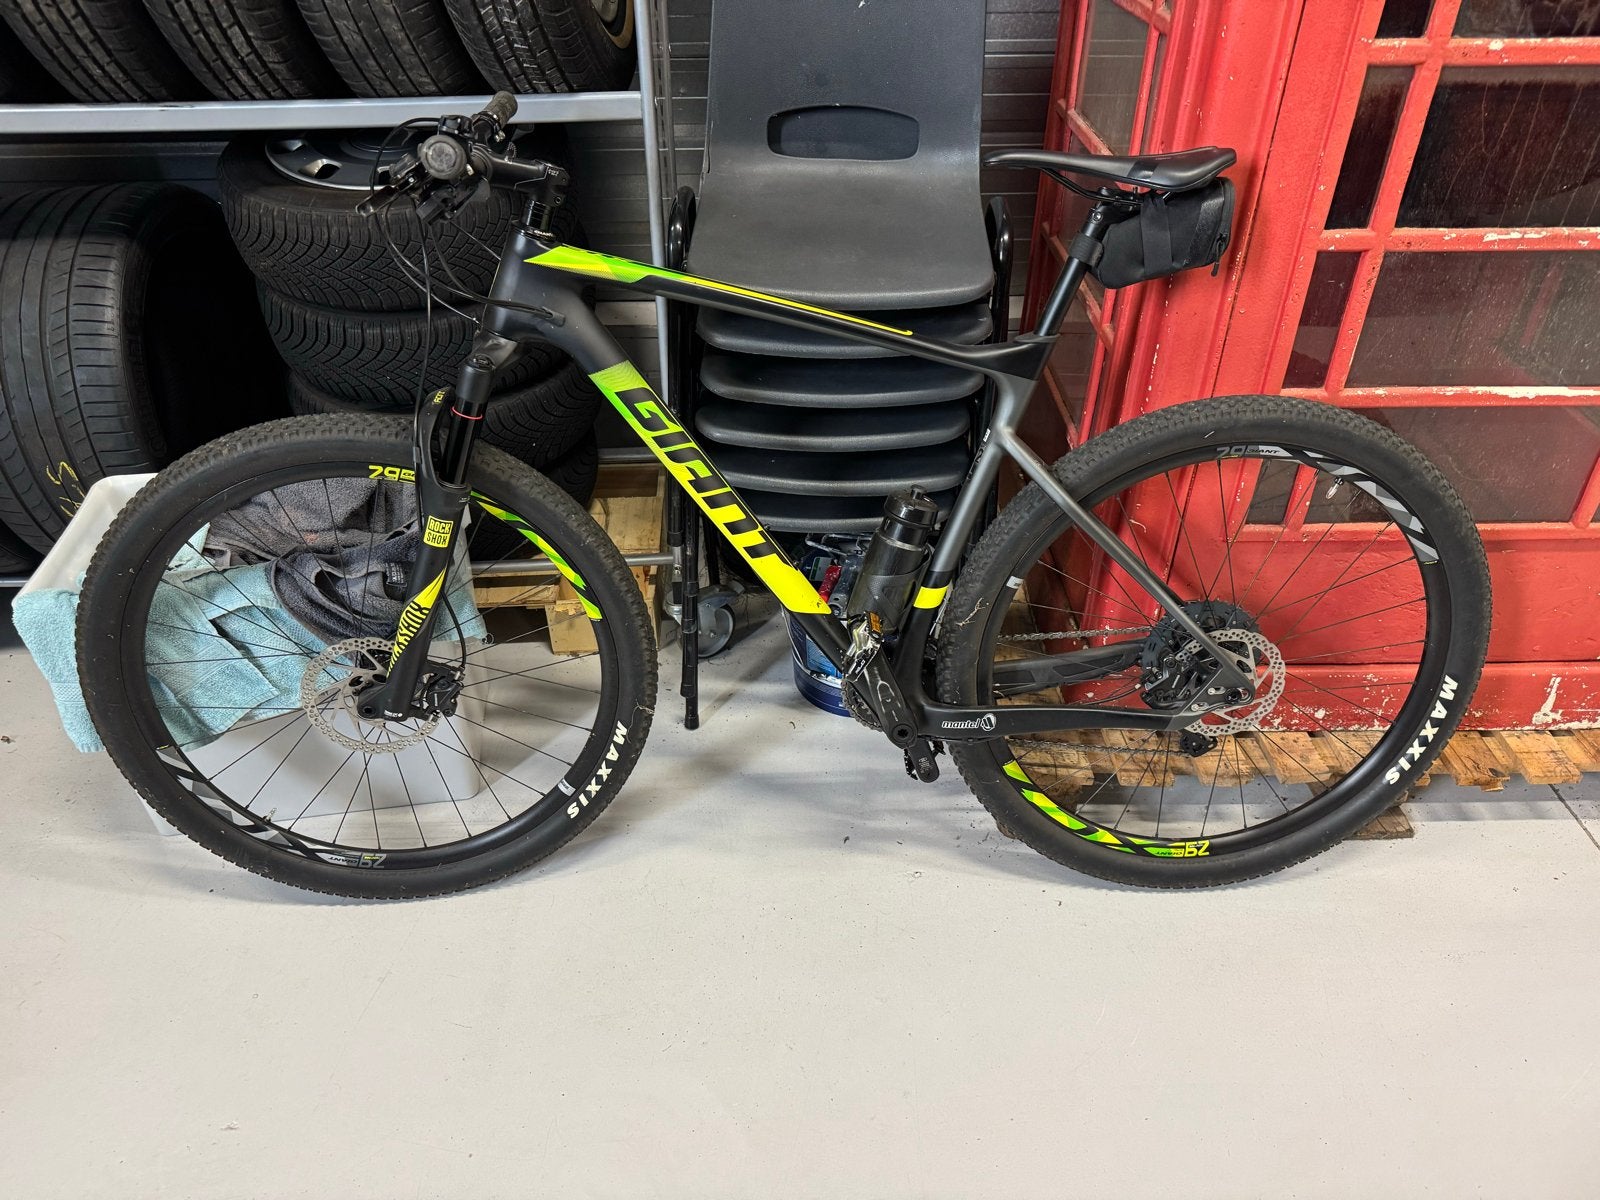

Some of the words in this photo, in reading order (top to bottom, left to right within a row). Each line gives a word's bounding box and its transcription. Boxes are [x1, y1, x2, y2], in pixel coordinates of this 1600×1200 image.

[368, 465, 400, 481] 29
[615, 386, 796, 568] GIANT
[428, 518, 452, 534] ROCK
[426, 531, 448, 546] SHOX
[941, 717, 981, 729] mantel
[1384, 674, 1459, 785] MAXXIS
[566, 720, 628, 819] MAXXIS
[1184, 840, 1210, 857] 29
[358, 853, 387, 869] 29
